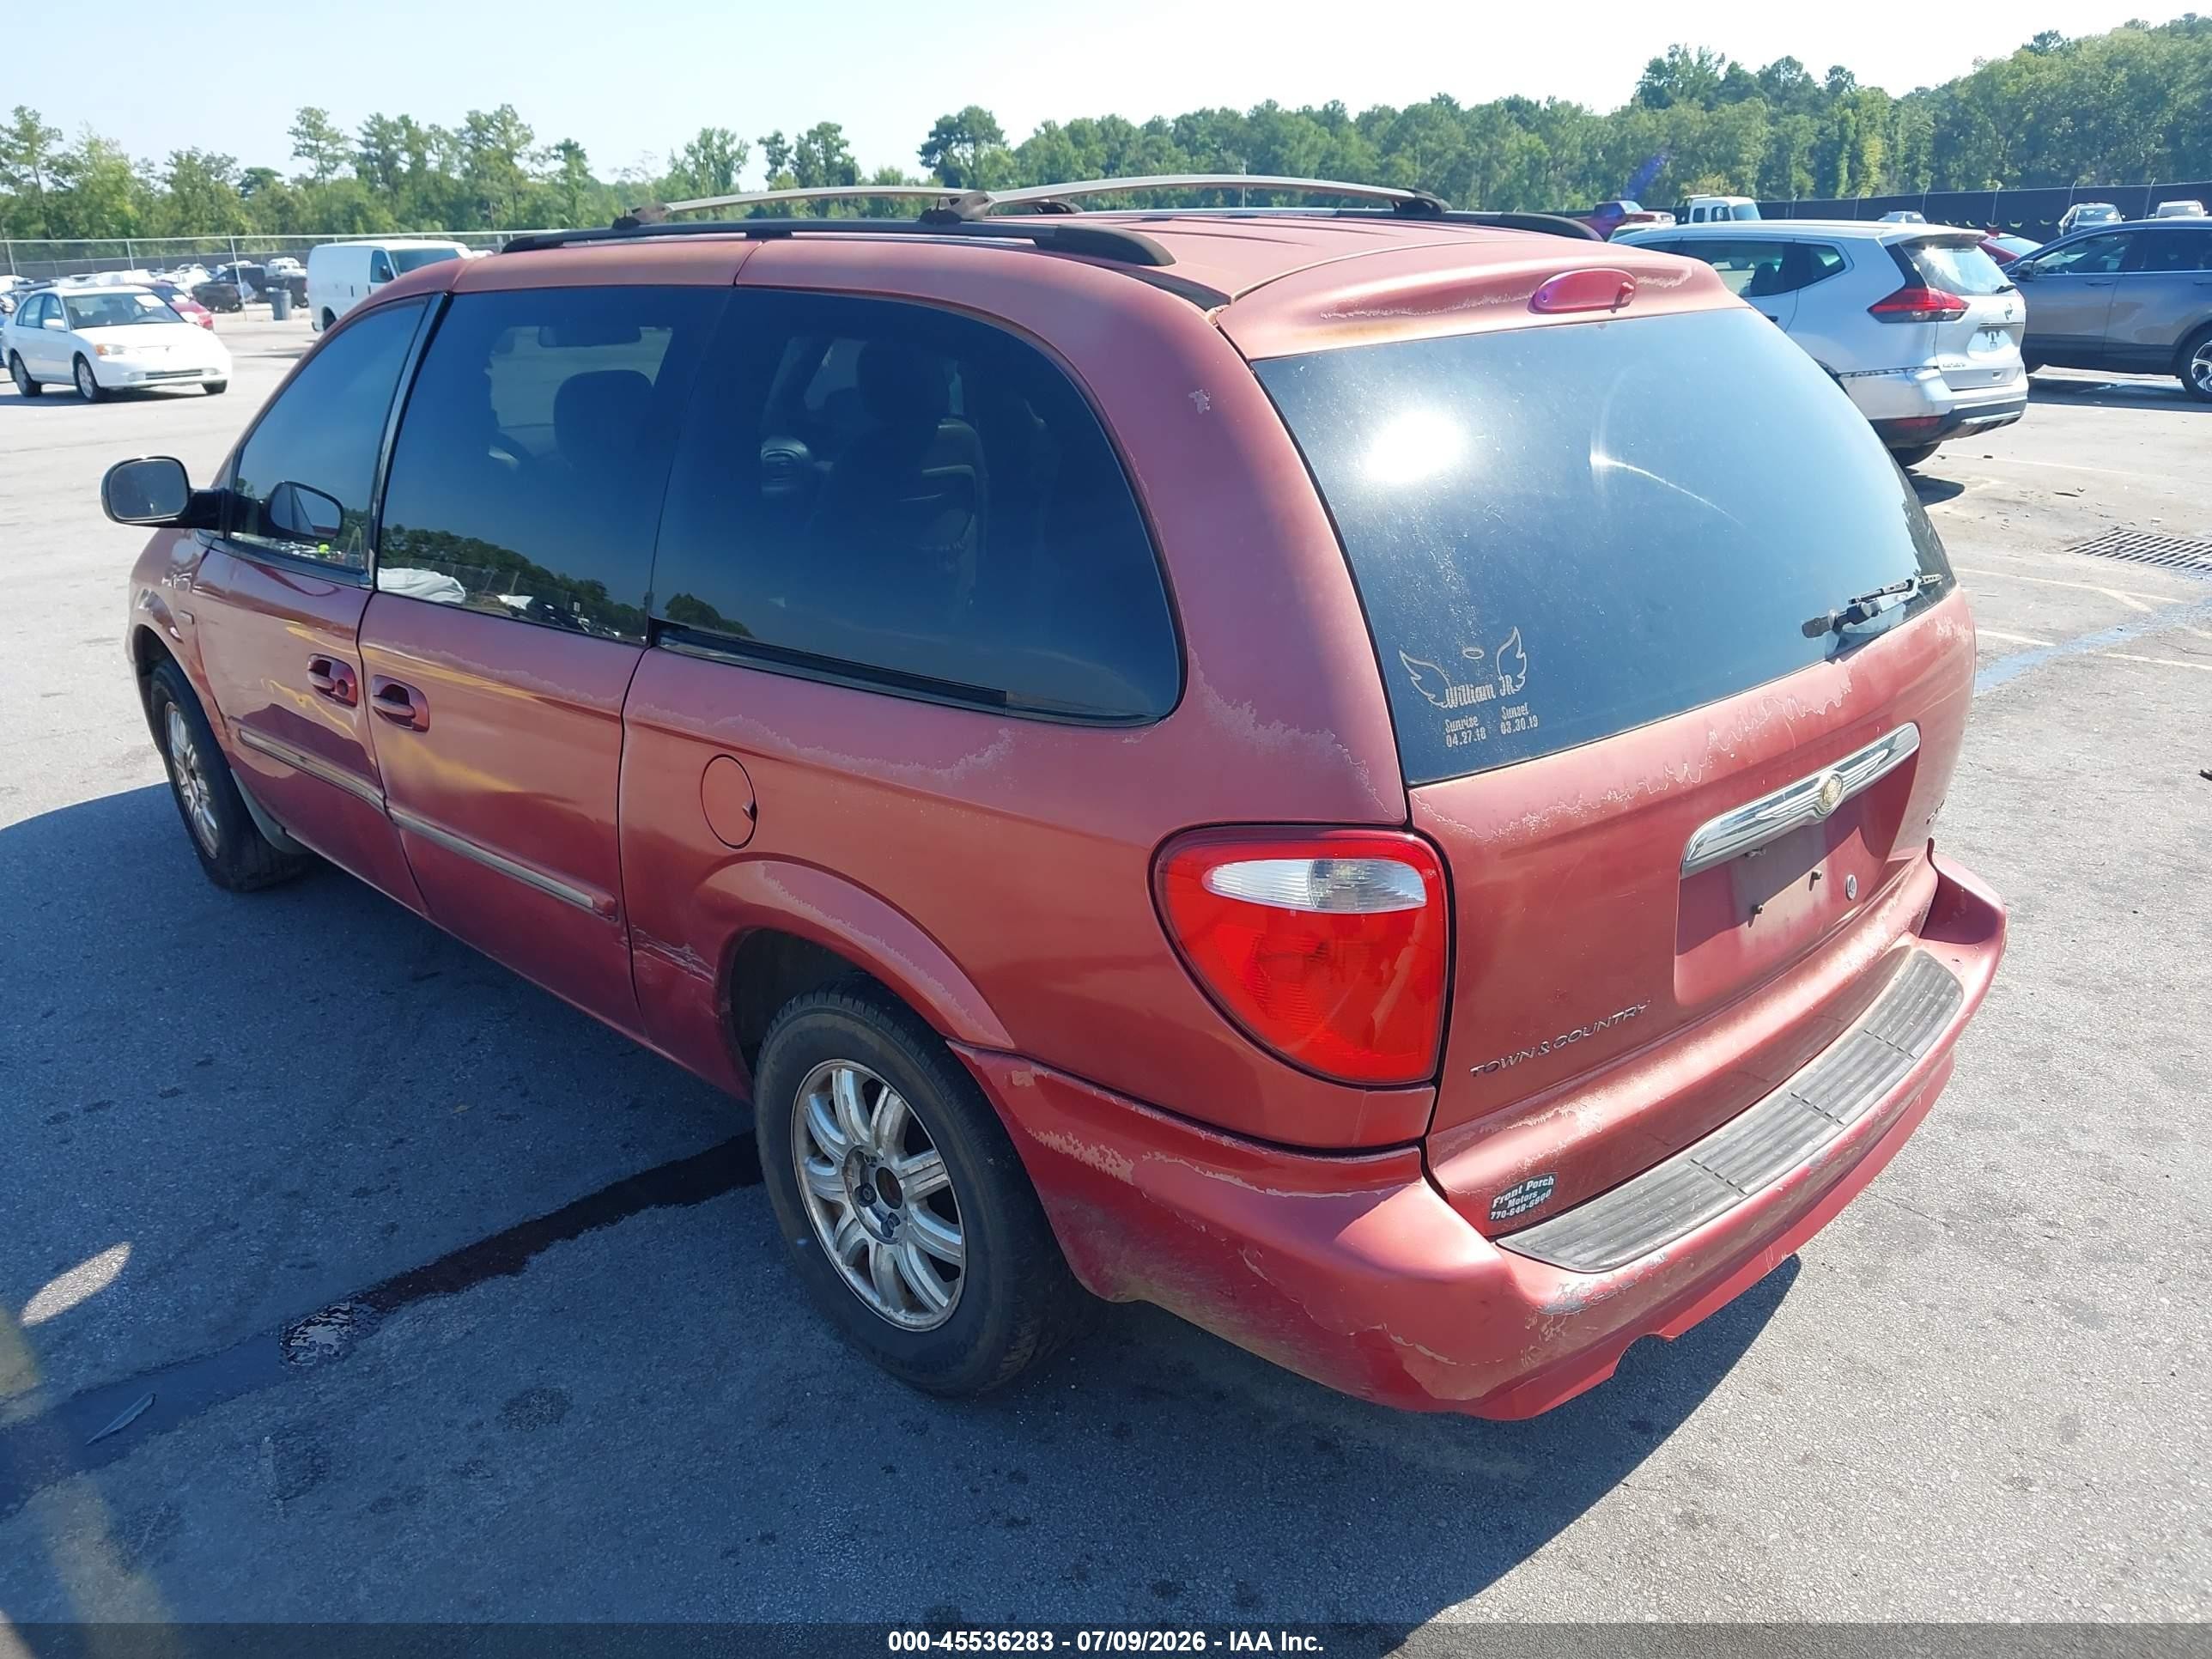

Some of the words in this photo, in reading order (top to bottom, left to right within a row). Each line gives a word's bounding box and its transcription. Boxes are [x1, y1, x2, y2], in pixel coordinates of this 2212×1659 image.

[1444, 684, 1496, 708] William
[1498, 674, 1514, 697] JR
[1501, 702, 1529, 720] Sunset
[1444, 715, 1479, 733] Sunrise
[1500, 715, 1539, 735] 03.30.19
[1492, 1184, 1523, 1209] Front
[1525, 1175, 1555, 1192] Porch
[1507, 1190, 1539, 1209] Motors
